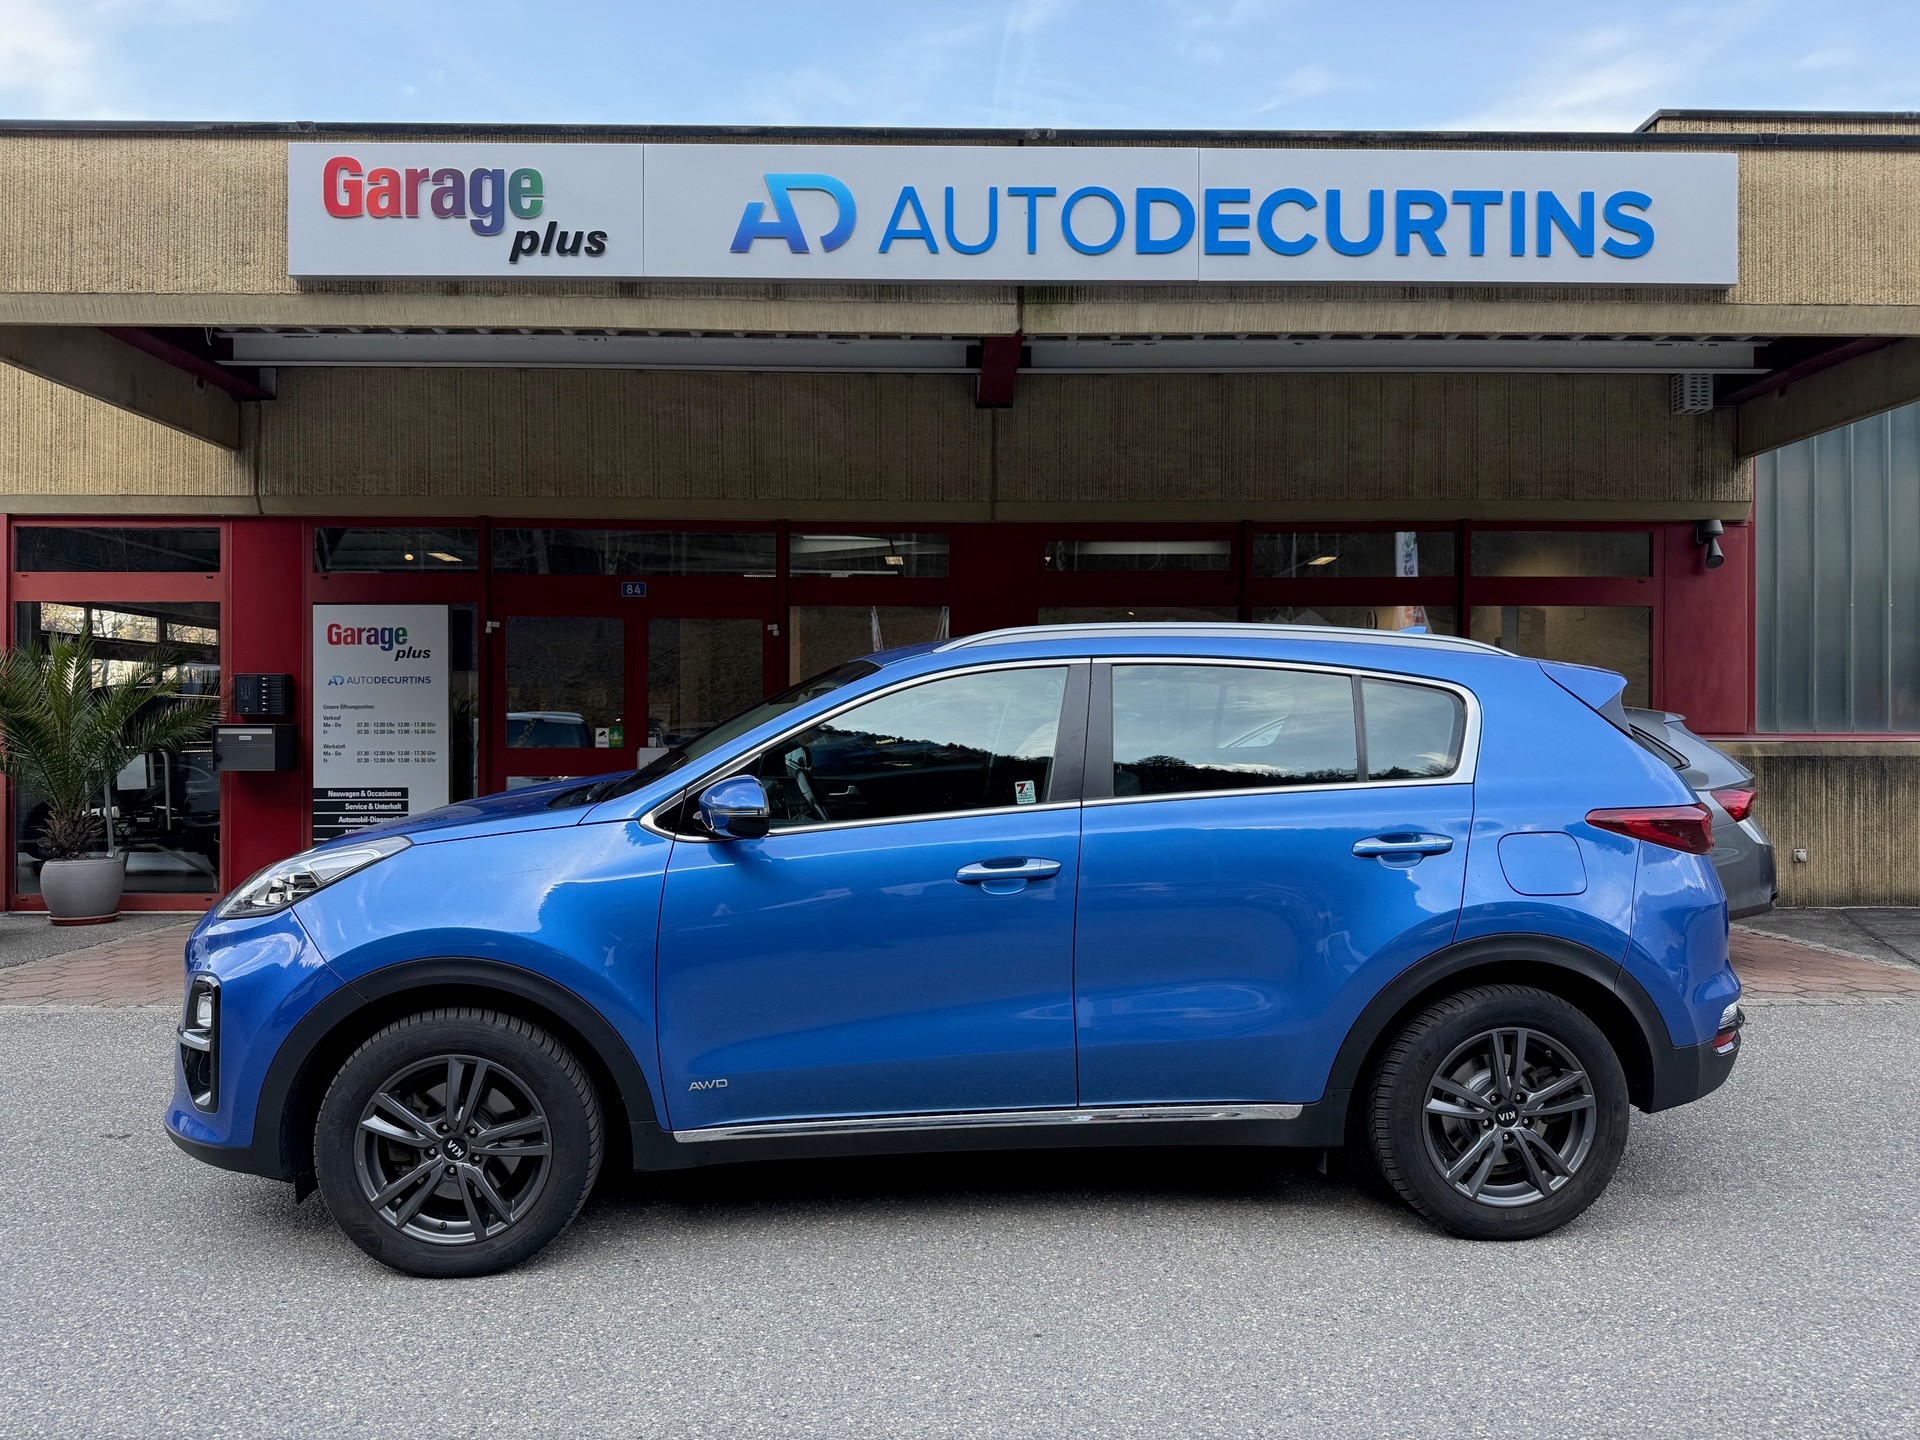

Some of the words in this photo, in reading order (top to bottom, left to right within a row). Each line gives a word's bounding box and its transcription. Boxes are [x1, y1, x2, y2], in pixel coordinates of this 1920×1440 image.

[323, 156, 544, 236] Garage
[878, 185, 1656, 259] AUTODECURTINS
[508, 221, 608, 265] plus
[626, 584, 641, 595] 84
[327, 623, 408, 651] Garage
[394, 646, 432, 662] plus
[346, 676, 432, 685] AUTODECURTINS
[327, 790, 360, 798] Neuwagen
[688, 1079, 728, 1091] AWD
[1498, 1110, 1516, 1121] KIA
[447, 1140, 464, 1158] KIA
